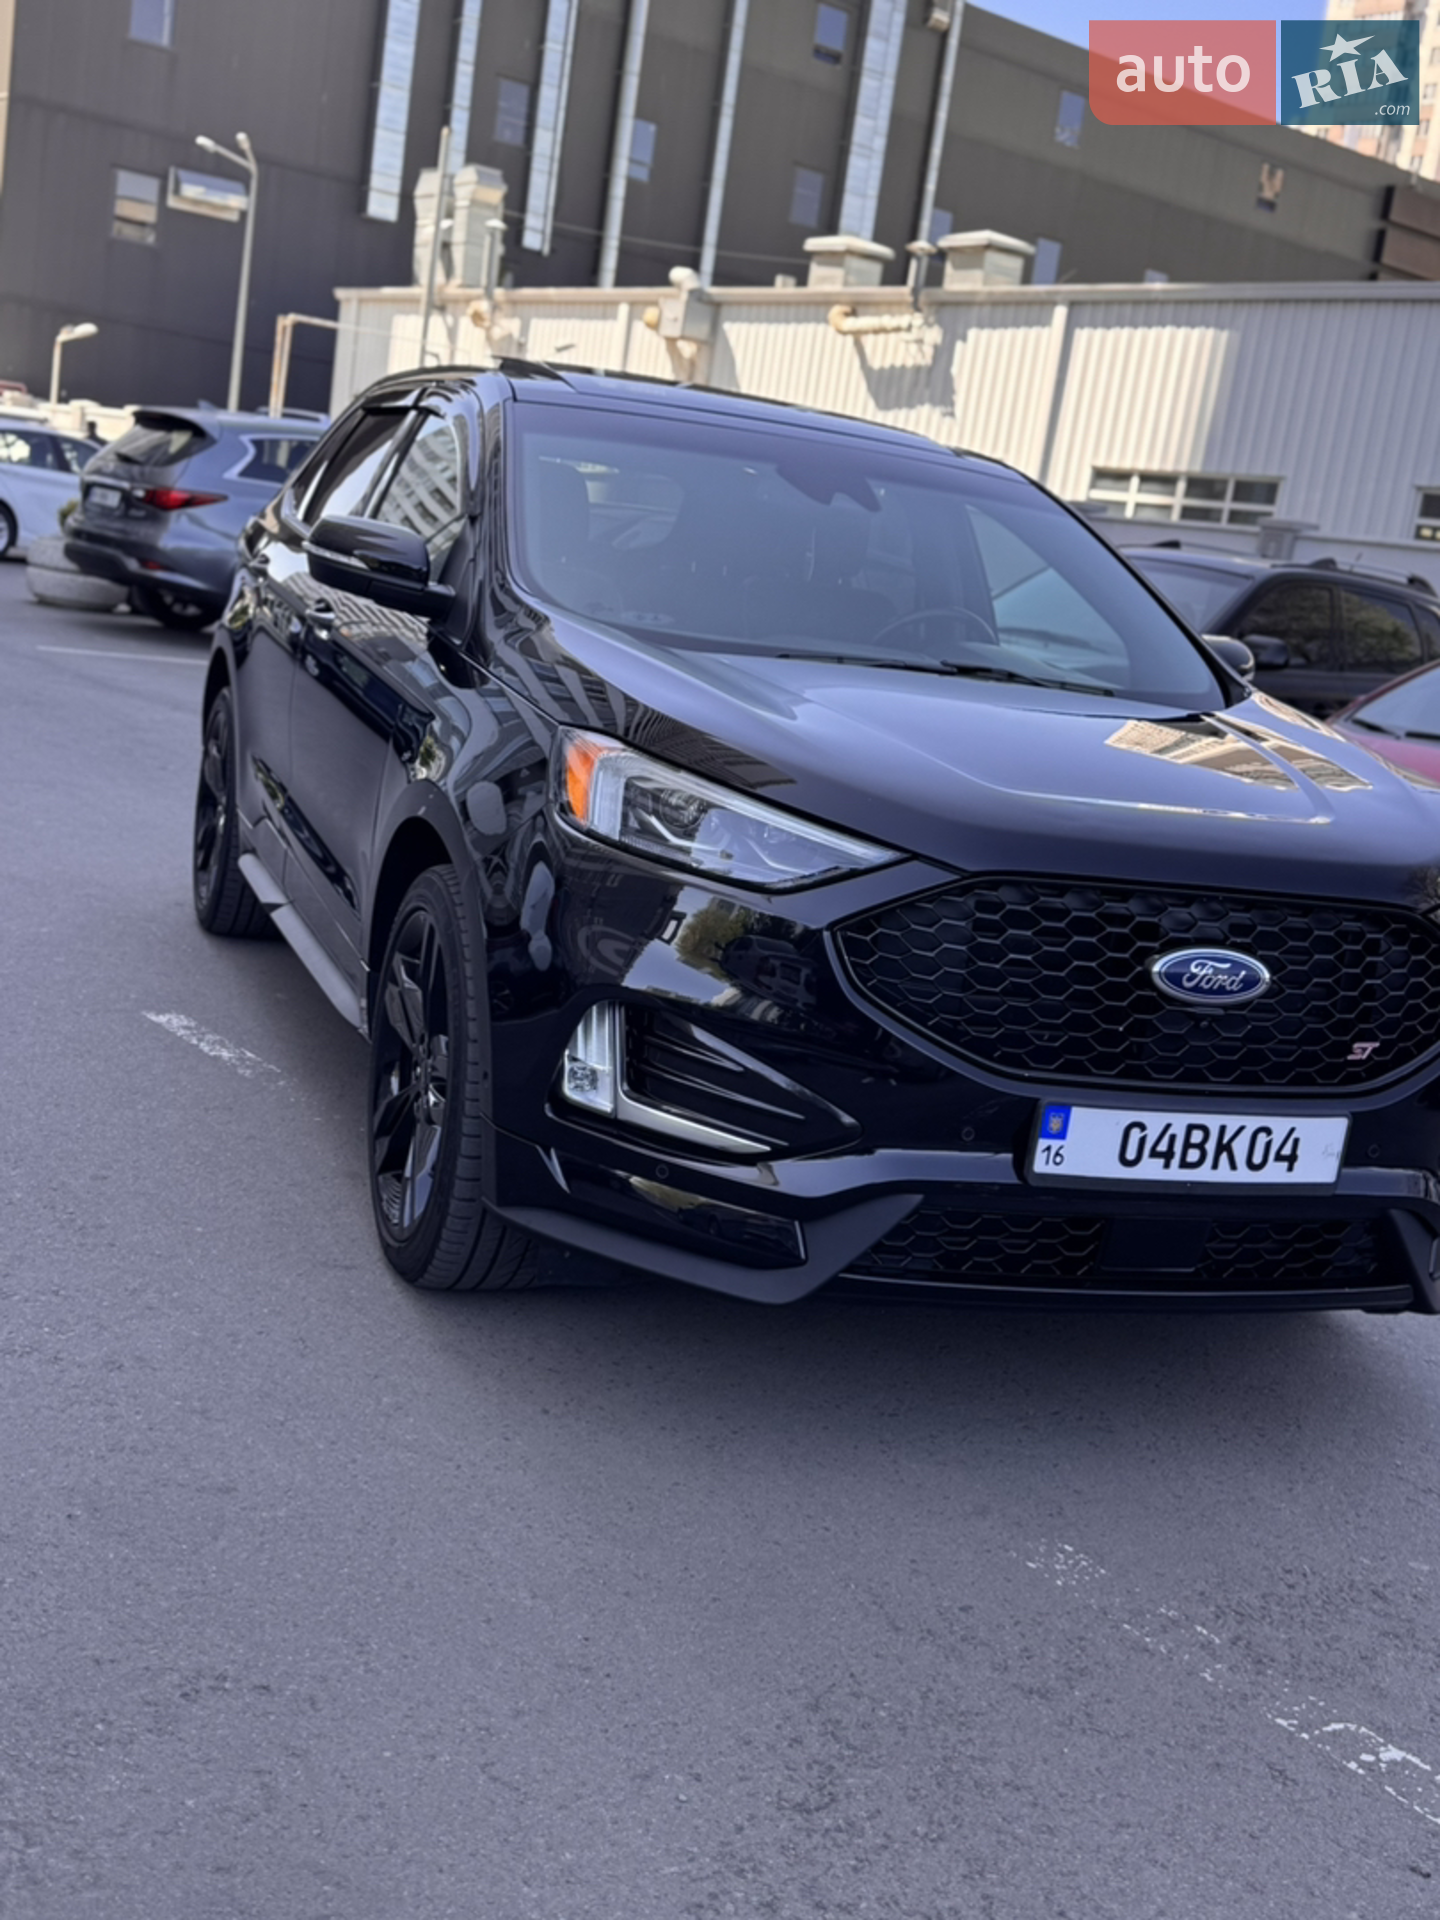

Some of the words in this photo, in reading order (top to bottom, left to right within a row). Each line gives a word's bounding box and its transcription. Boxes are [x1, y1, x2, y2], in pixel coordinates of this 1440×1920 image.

[1182, 959, 1246, 991] Ford
[1347, 1041, 1380, 1060] ST
[1041, 1144, 1065, 1167] 16
[1118, 1121, 1300, 1173] 04BK04
